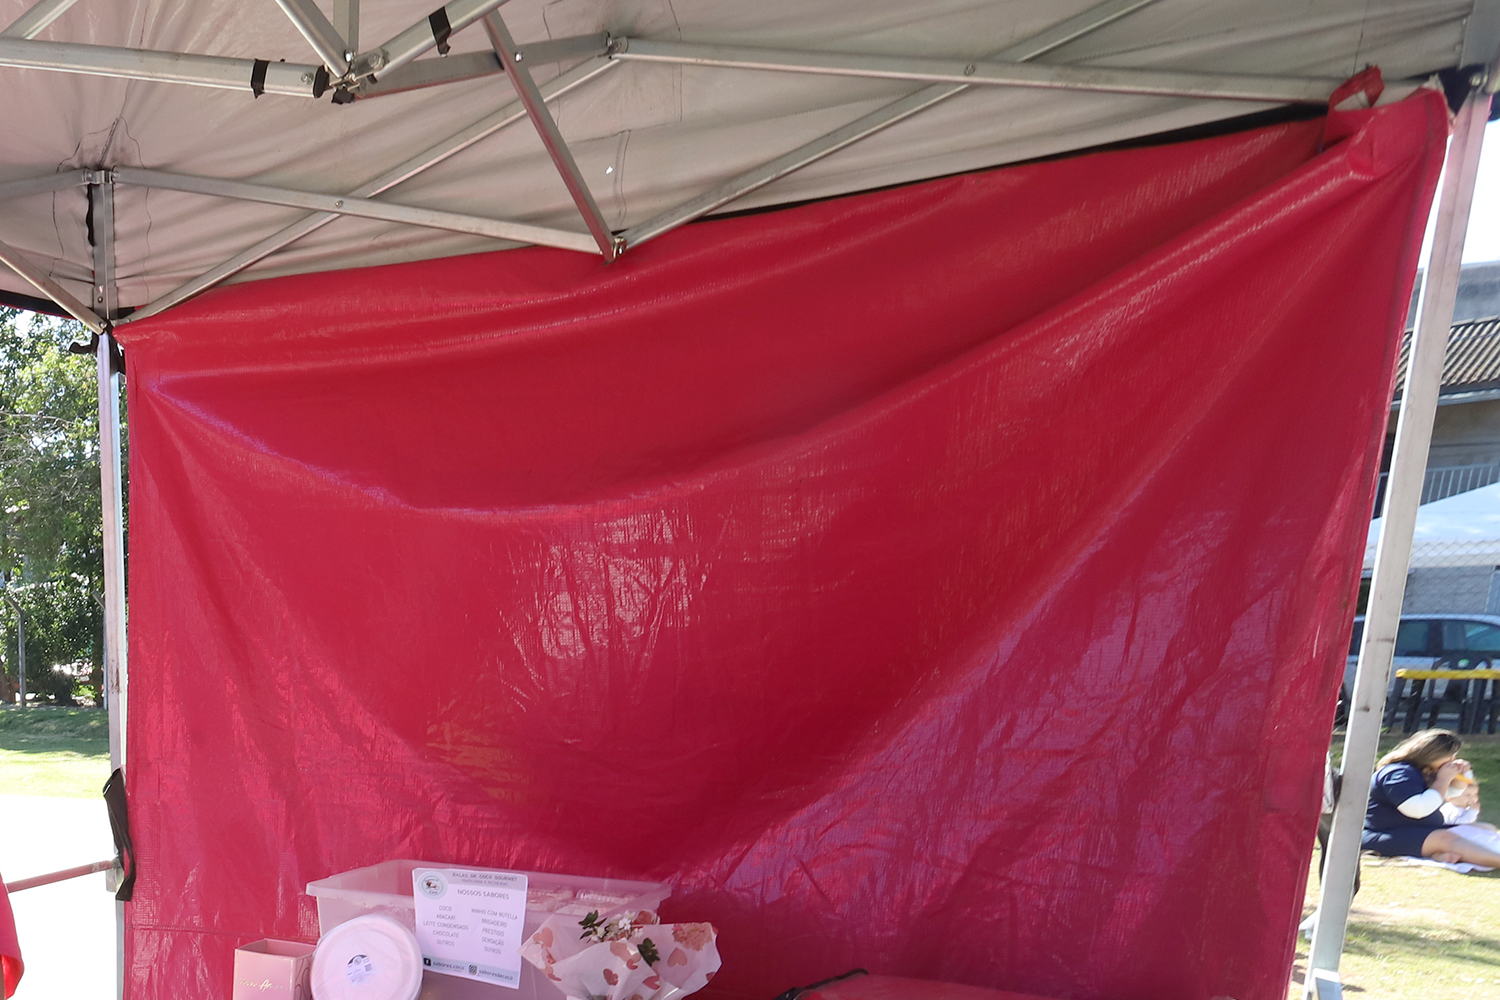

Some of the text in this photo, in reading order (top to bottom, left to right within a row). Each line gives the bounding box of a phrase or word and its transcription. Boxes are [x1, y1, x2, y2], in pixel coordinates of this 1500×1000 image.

[457, 889, 510, 900] NOSSOS SABORES
[432, 930, 459, 938] CHOCOLATE
